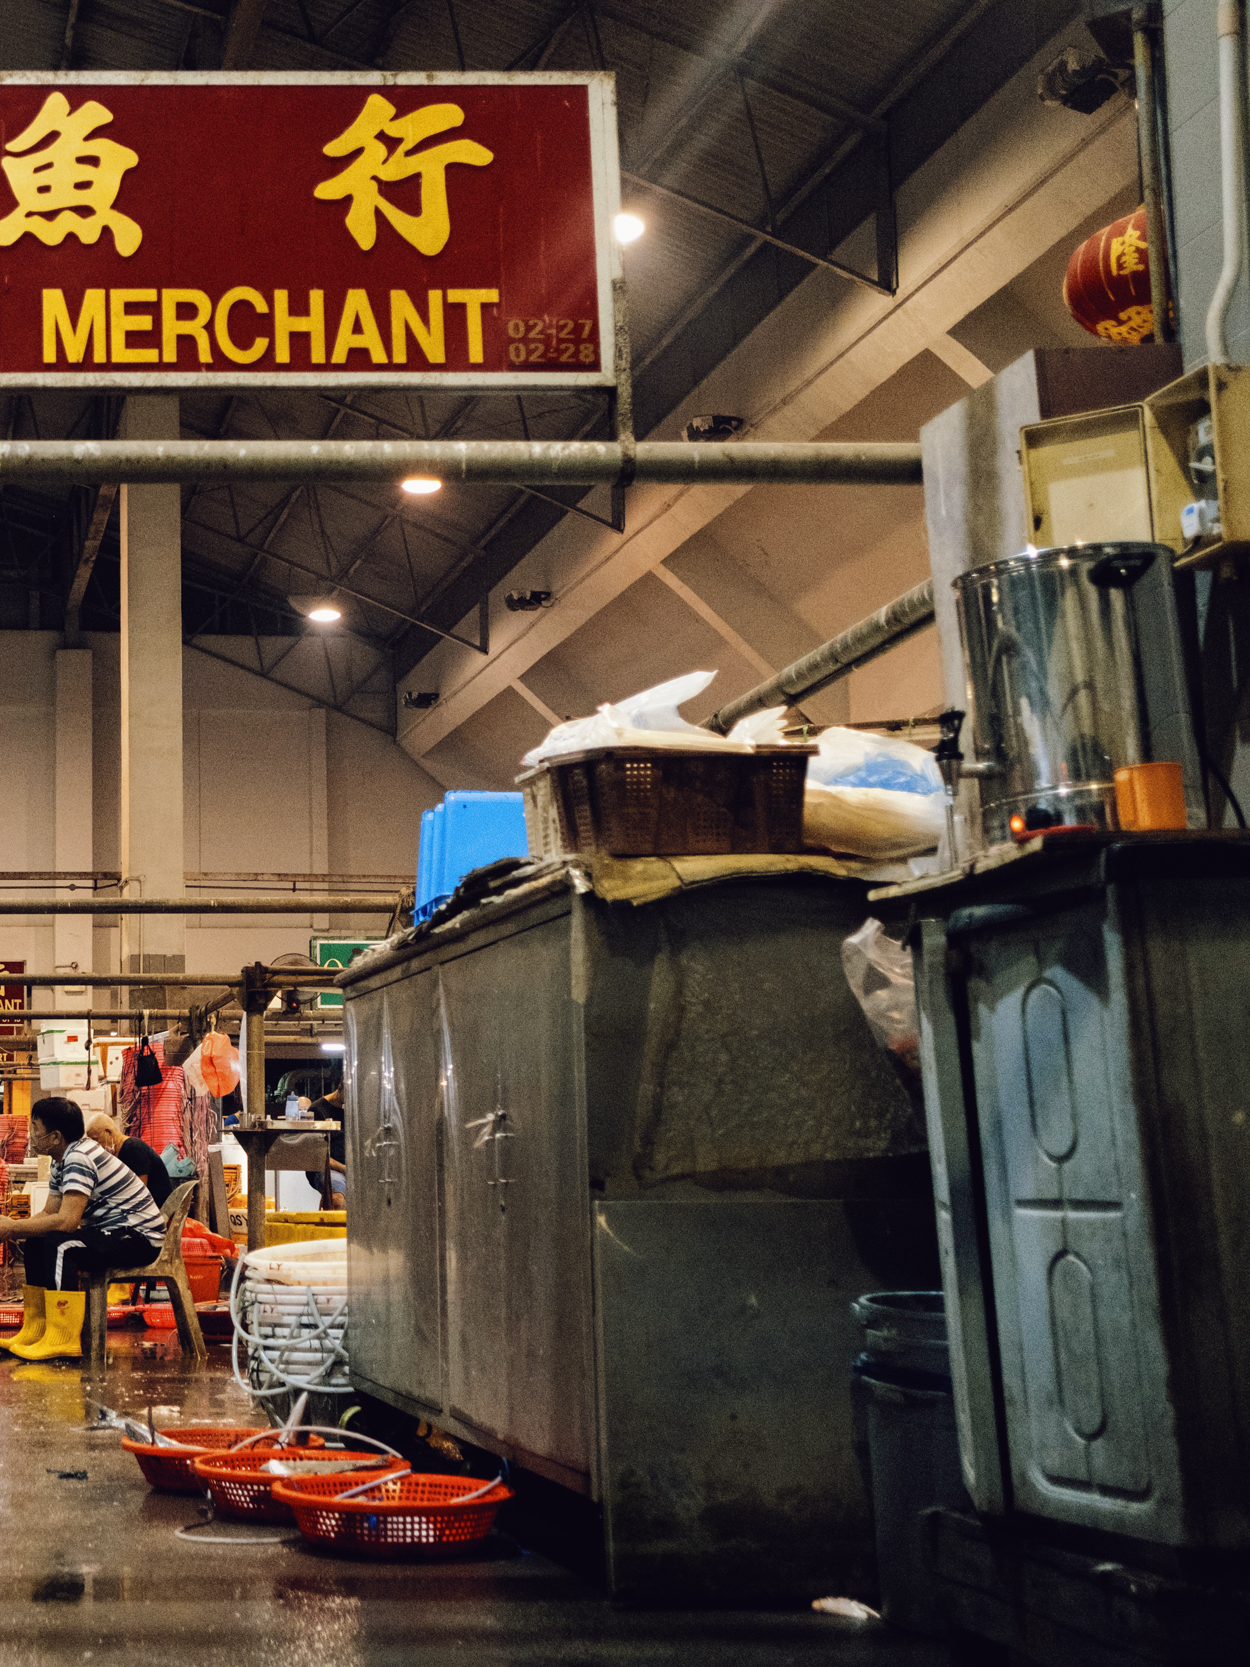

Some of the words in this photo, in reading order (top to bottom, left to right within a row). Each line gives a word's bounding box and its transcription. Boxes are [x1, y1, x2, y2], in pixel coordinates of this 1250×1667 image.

[41, 286, 500, 364] MERCHANT
[507, 319, 593, 339] 02-27
[508, 343, 596, 362] 02-28
